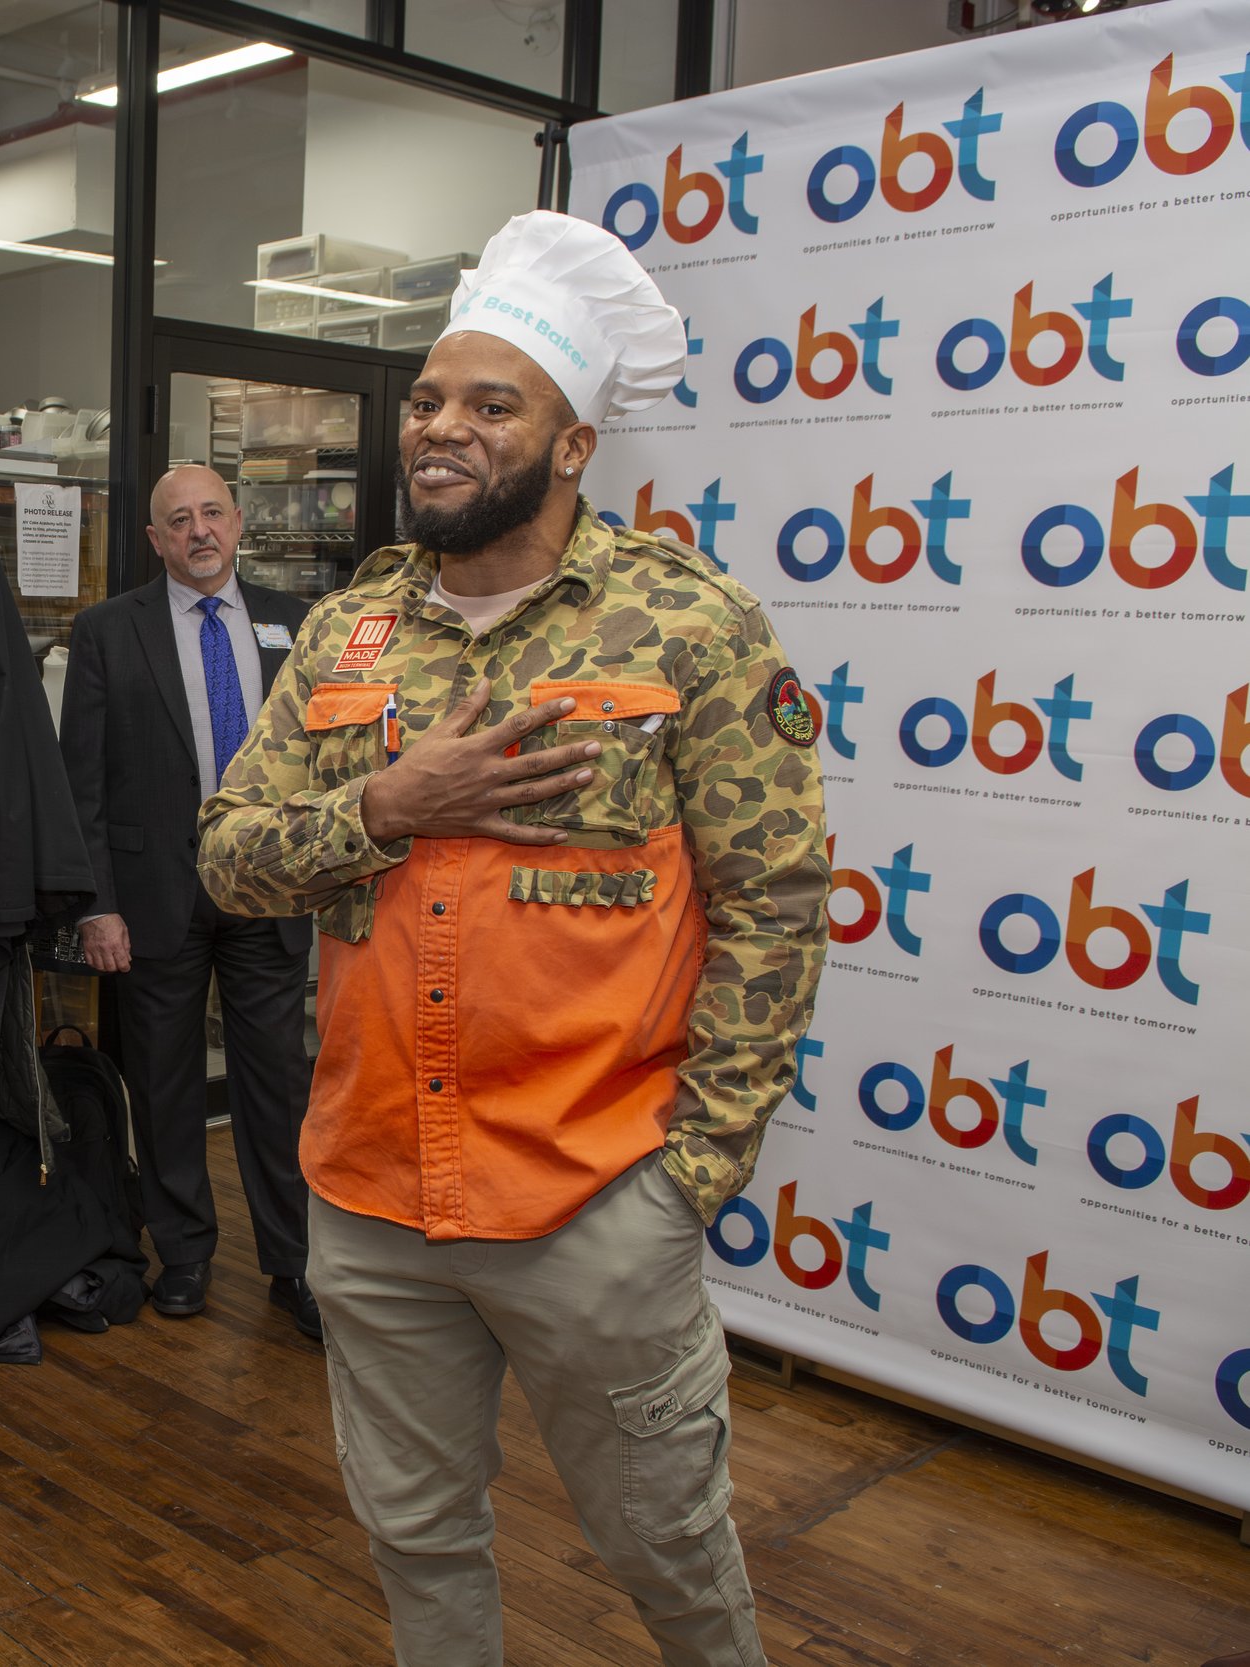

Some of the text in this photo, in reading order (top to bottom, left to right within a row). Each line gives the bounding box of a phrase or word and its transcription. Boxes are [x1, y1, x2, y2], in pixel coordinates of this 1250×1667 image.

[807, 86, 1003, 223] obt
[602, 130, 764, 252] obt
[1050, 204, 1134, 223] opportunities
[1139, 201, 1158, 211] for
[1174, 194, 1215, 207] better
[802, 238, 872, 254] opportunities
[875, 235, 891, 244] for
[903, 229, 937, 241] better
[941, 222, 996, 236] tomorrow
[483, 296, 534, 326] Best
[534, 318, 589, 371] Baker
[734, 296, 900, 404] obt
[936, 272, 1133, 391] obt
[729, 419, 788, 429] opportunities
[790, 417, 804, 425] for
[814, 416, 843, 424] better
[846, 413, 892, 422] tomorrow
[930, 407, 1000, 418] opportunities
[1003, 405, 1019, 414] for
[1032, 404, 1066, 413] better
[1069, 401, 1124, 411] tomorrow
[24, 508, 73, 517] PHOTO RELEASE
[777, 470, 971, 585] obt
[1021, 462, 1250, 590] obt
[771, 600, 839, 609] opportunities
[842, 600, 858, 610] for
[870, 602, 904, 611] better
[907, 603, 961, 613] tomorrow
[1014, 607, 1097, 617] opportunities
[1101, 608, 1120, 618] for
[1135, 609, 1177, 620] better
[1181, 611, 1246, 622] tomorrow
[343, 650, 379, 661] MADE
[773, 707, 793, 735] POLO
[899, 669, 1093, 783] obt
[893, 782, 961, 795] opportunities
[964, 788, 980, 797] for
[992, 791, 1026, 802] better
[1028, 795, 1082, 808] tomorrow
[1127, 806, 1208, 822] opportunities
[1212, 813, 1230, 824] for
[979, 867, 1211, 1006] obt
[830, 959, 864, 973] better
[867, 967, 920, 984] tomorrow
[972, 987, 1053, 1009] opportunities
[1056, 1001, 1075, 1012] for
[1090, 1007, 1130, 1022] better
[1133, 1015, 1197, 1035] tomorrow
[771, 1117, 815, 1135] tomorrow
[858, 1043, 1047, 1167] obt
[852, 1139, 919, 1161] opportunities
[921, 1155, 937, 1166] for
[948, 1162, 982, 1177] better
[984, 1171, 1036, 1191] tomorrow
[1086, 1095, 1250, 1211] ob
[1079, 1197, 1158, 1223] opportunities
[1161, 1216, 1179, 1228] for
[1193, 1224, 1232, 1241] better
[705, 1180, 890, 1313] obt
[767, 1293, 783, 1305] for
[793, 1302, 826, 1319] better
[828, 1314, 880, 1337] tomorrow
[936, 1250, 1161, 1398] obt
[930, 1348, 1008, 1379] opportunities
[1012, 1373, 1030, 1386] for
[1043, 1384, 1082, 1403] better
[1086, 1398, 1147, 1424] tomorrow
